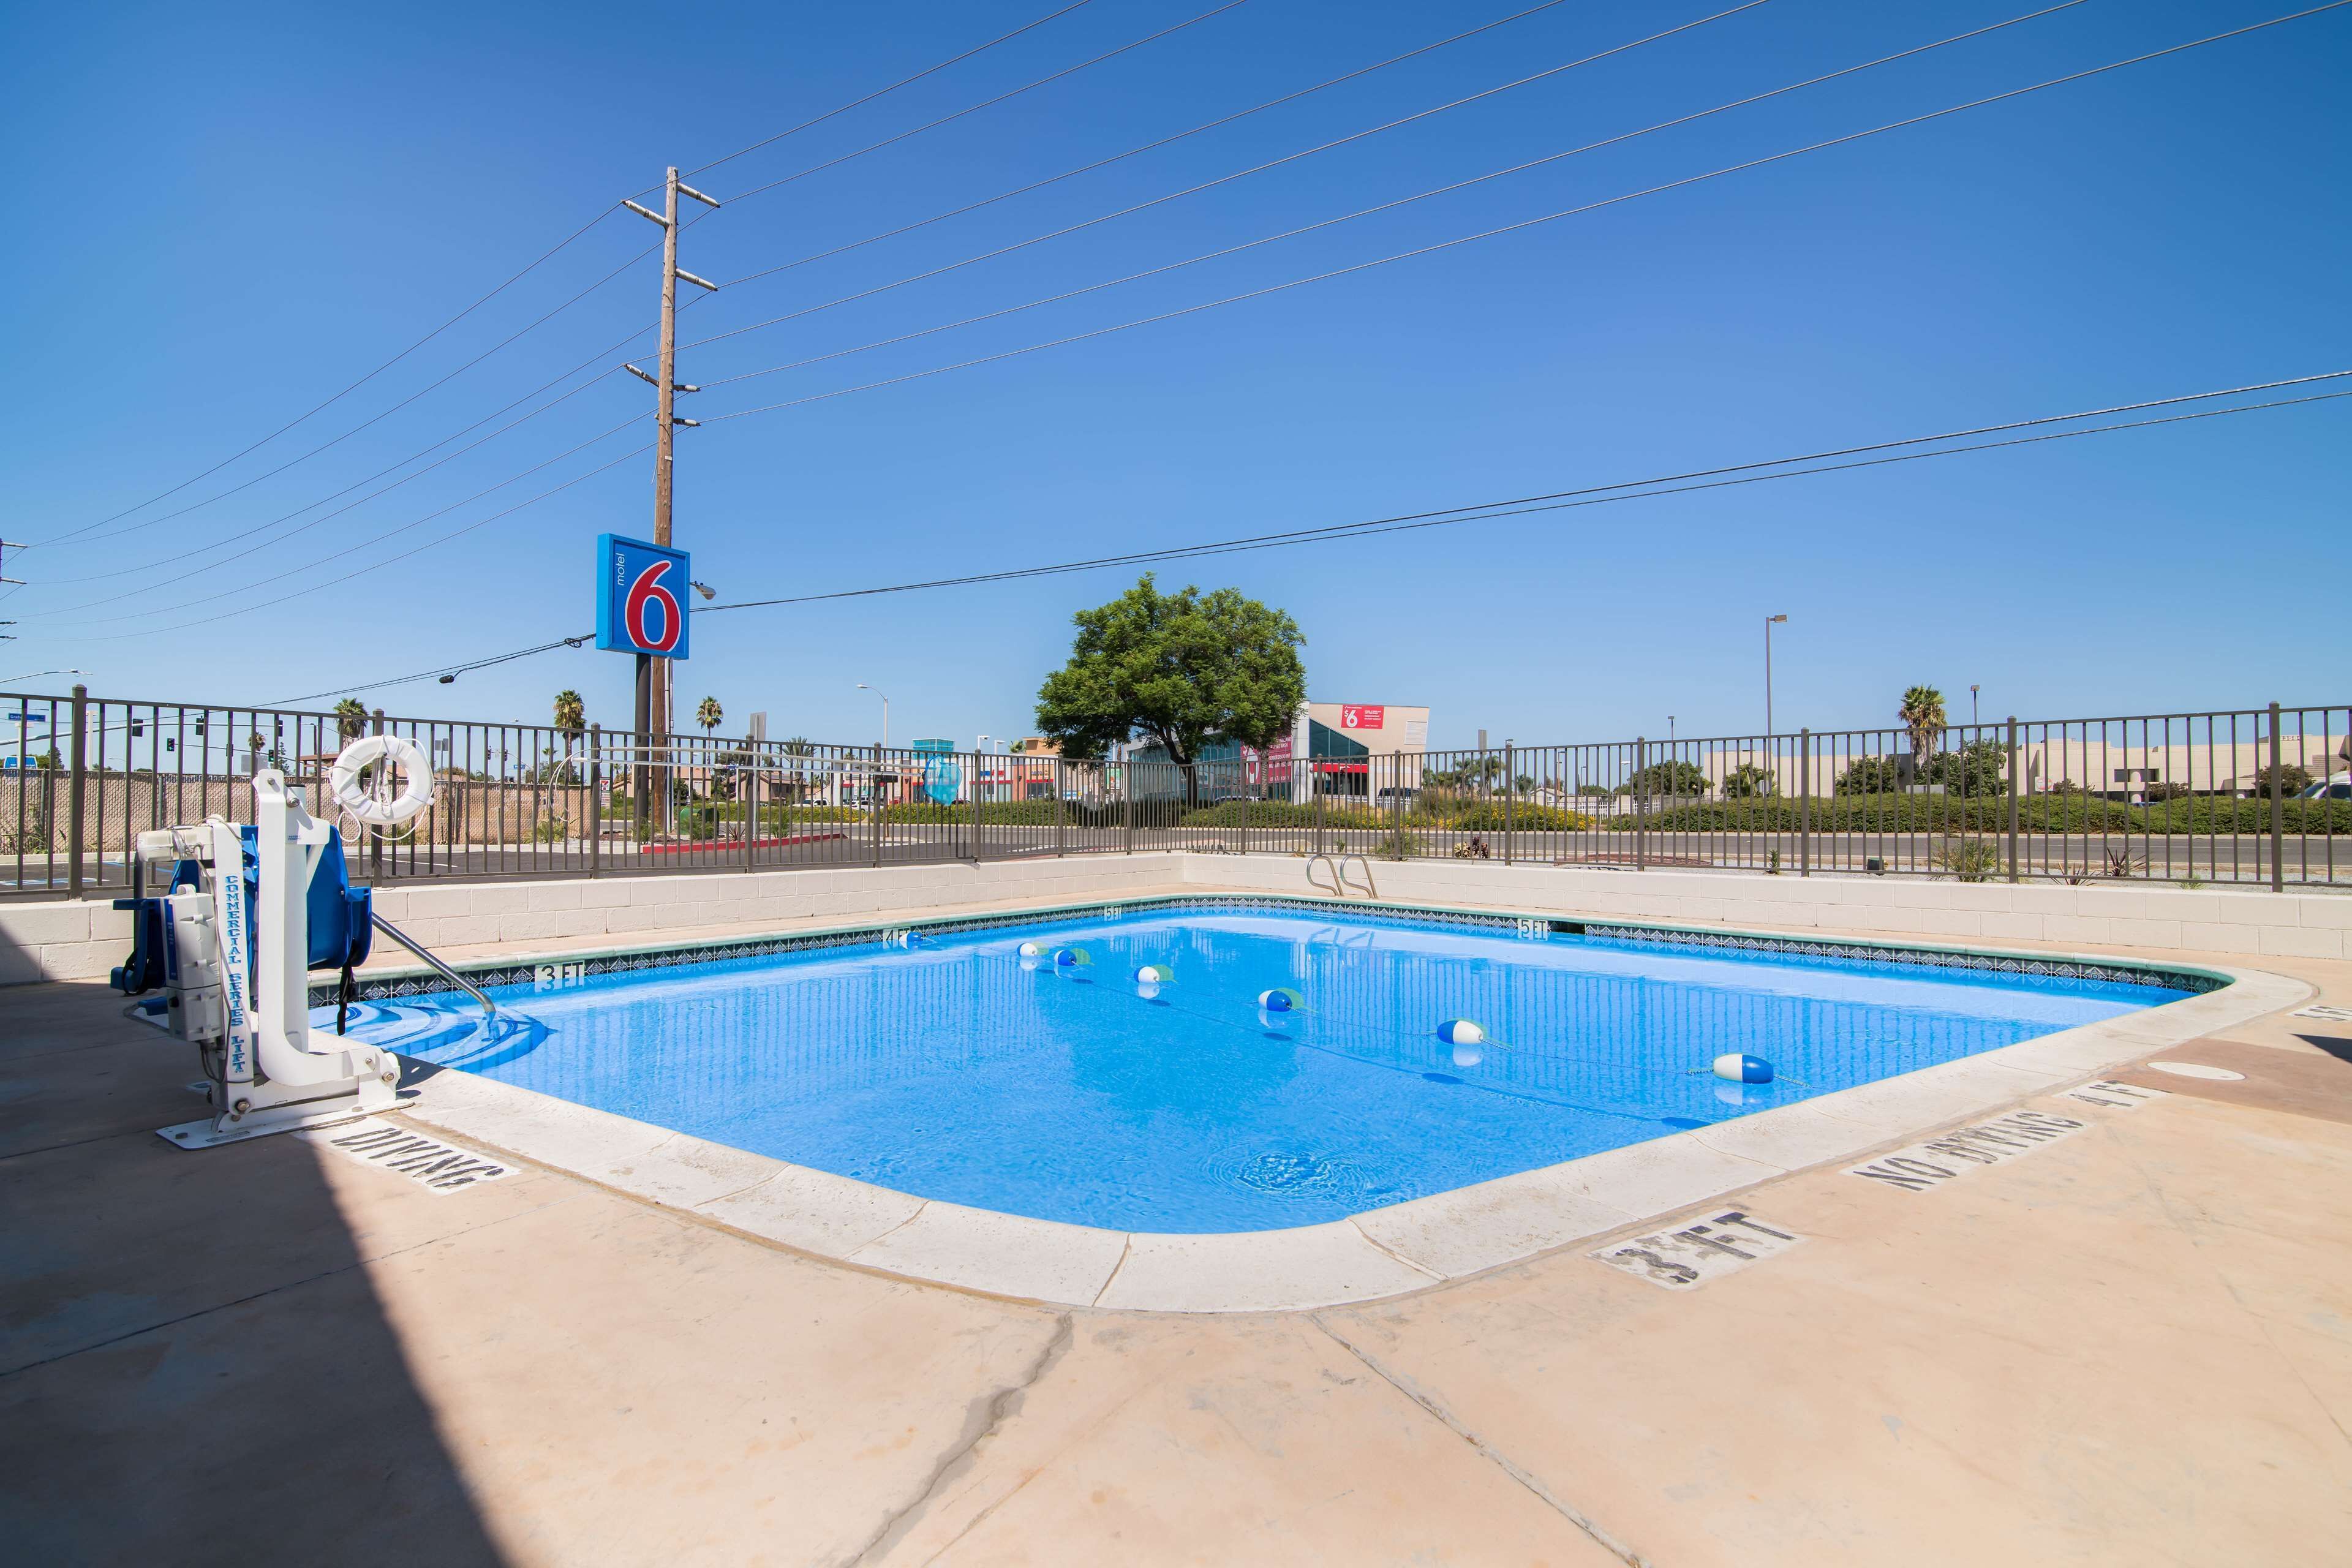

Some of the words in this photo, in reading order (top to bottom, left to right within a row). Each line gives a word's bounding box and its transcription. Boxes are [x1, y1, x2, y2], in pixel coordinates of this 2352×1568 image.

[616, 552, 625, 586] motel
[625, 560, 682, 652] 6
[1344, 709, 1358, 728] $6
[225, 875, 242, 964] COMMERCIAL
[541, 965, 556, 980] 3
[562, 962, 584, 979] FT
[229, 973, 244, 1027] SERIES
[231, 1035, 246, 1071] LIFT
[330, 1127, 505, 1188] DIVING
[1852, 1157, 1958, 1191] NO
[1924, 1112, 2084, 1164] DIVING
[1615, 1248, 1700, 1284] 3
[1675, 1211, 1798, 1260] FT
